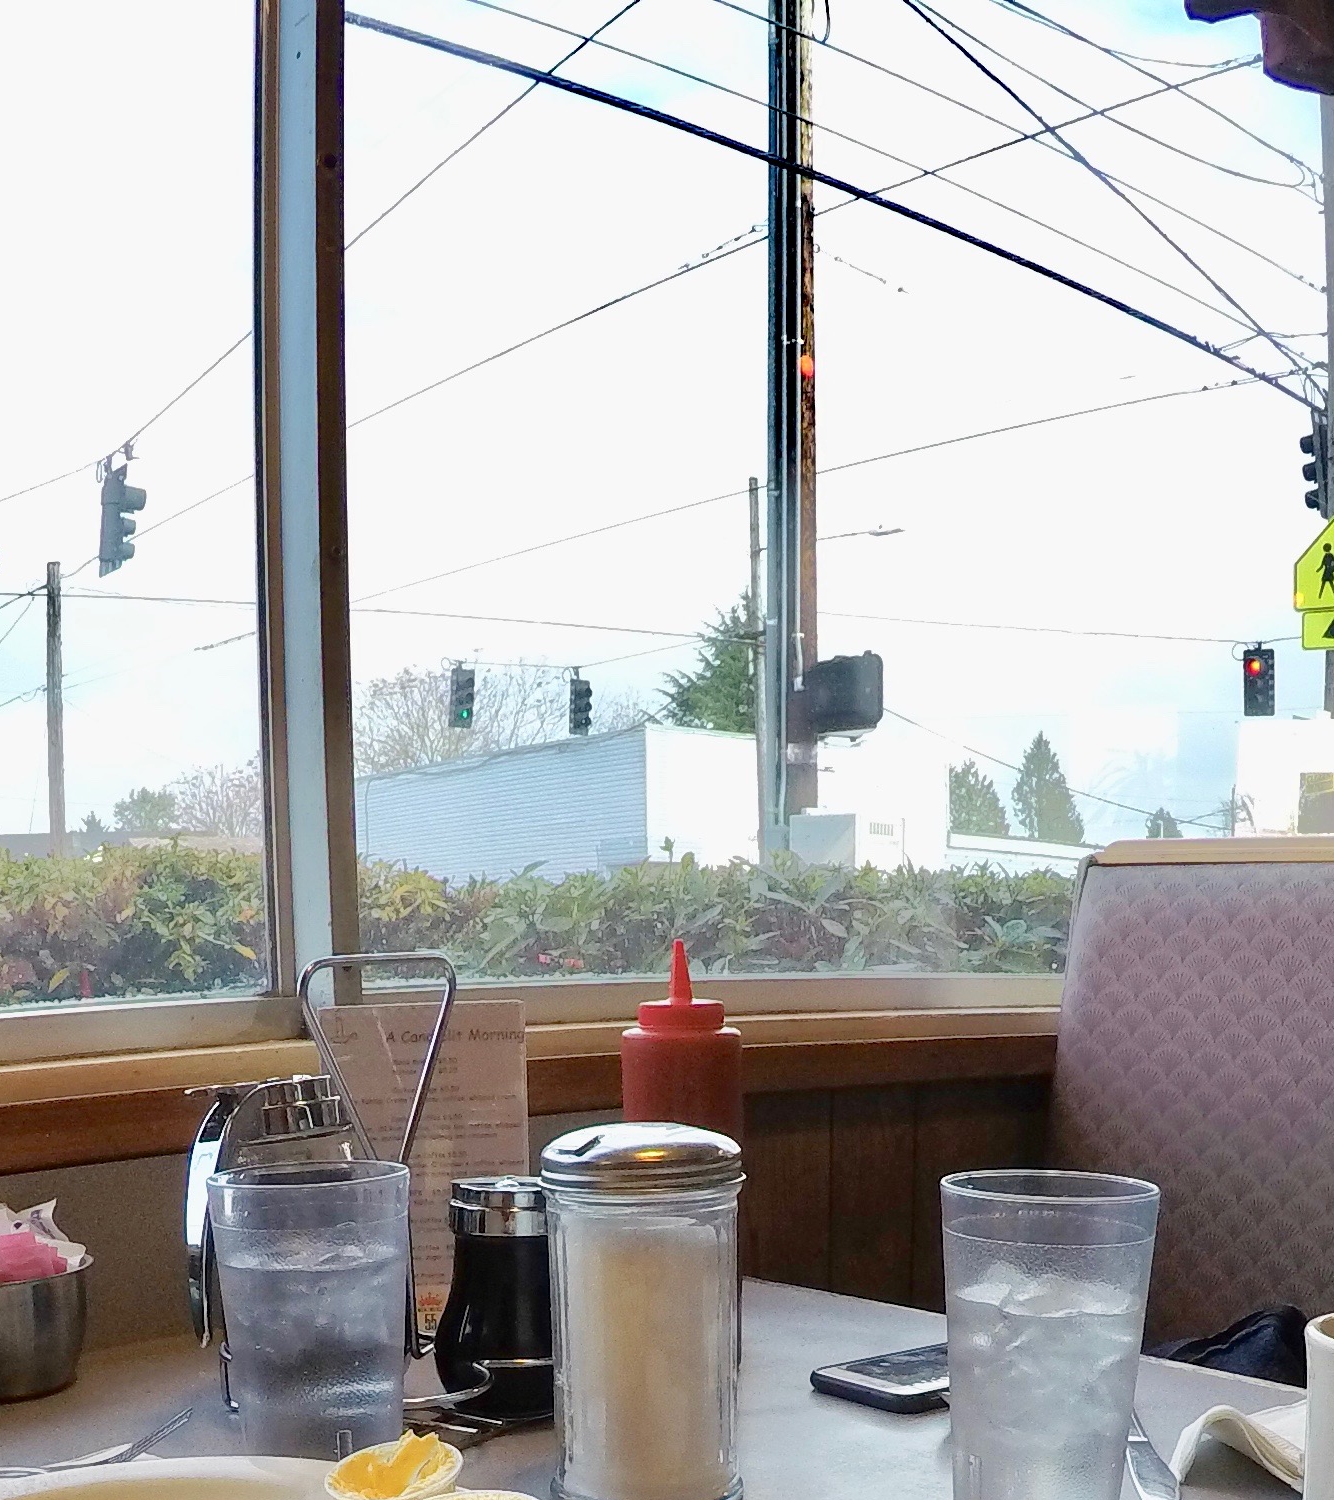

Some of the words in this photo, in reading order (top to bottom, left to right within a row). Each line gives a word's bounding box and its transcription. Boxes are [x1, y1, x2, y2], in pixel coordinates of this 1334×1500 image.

[386, 1033, 395, 1043] A
[400, 1029, 462, 1044] Canlit
[468, 1028, 526, 1044] Morning
